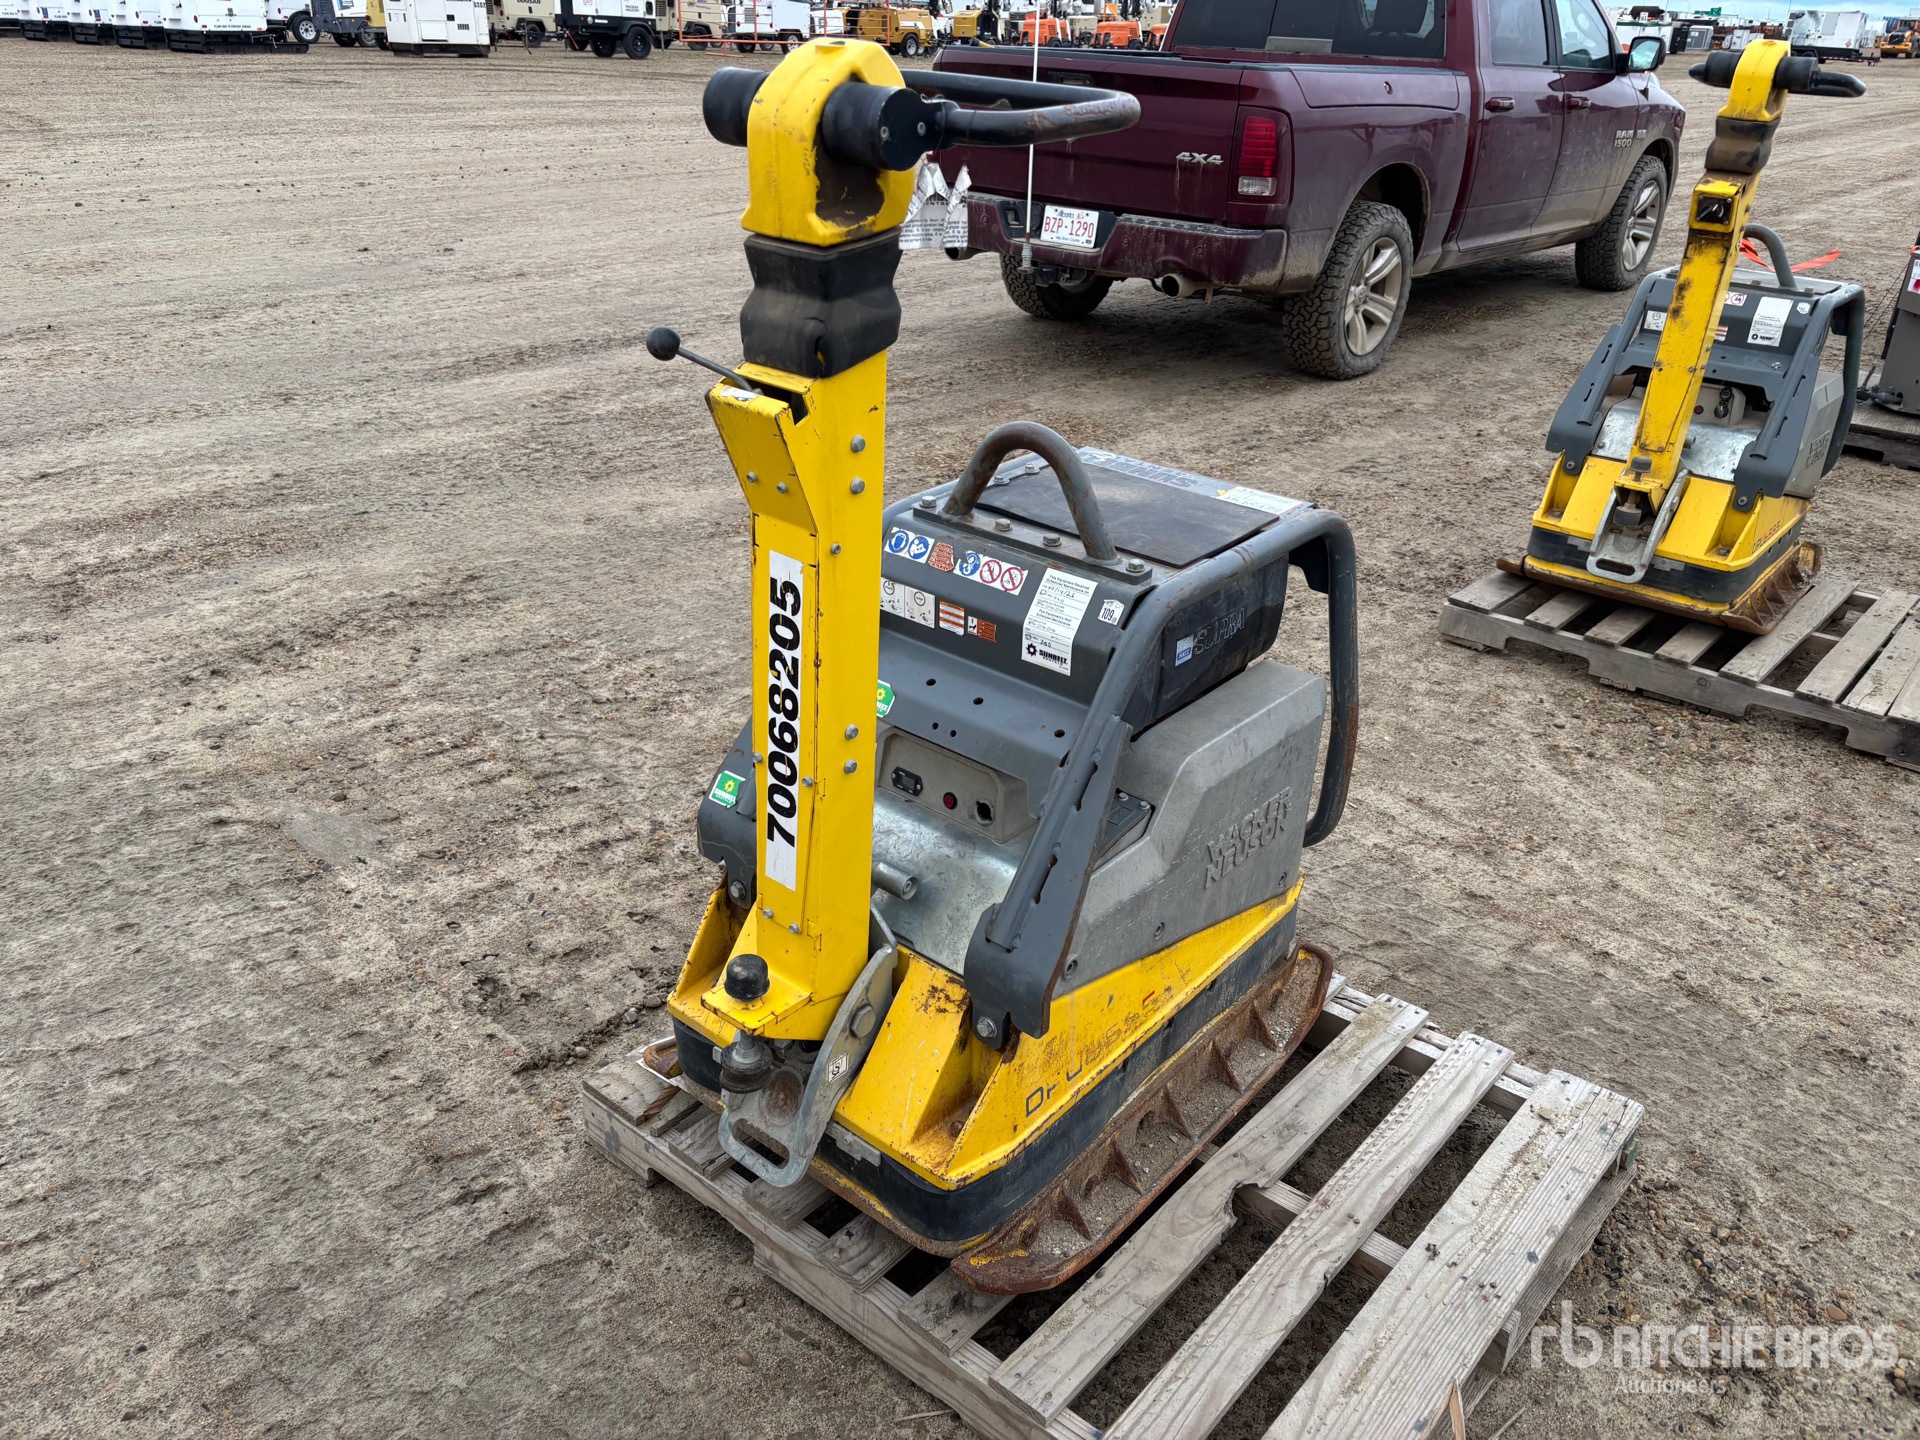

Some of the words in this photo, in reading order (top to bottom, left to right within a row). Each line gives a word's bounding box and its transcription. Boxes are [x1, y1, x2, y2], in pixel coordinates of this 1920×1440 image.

[1613, 139, 1632, 148] 1500
[1615, 130, 1634, 139] RAM
[1044, 216, 1095, 238] BZP-1290
[1101, 607, 1115, 621] 109
[1194, 607, 1245, 655] SUPRA
[1039, 649, 1068, 664] SUNBELT
[767, 576, 801, 848] 70068205
[1204, 815, 1286, 890] NEUSON
